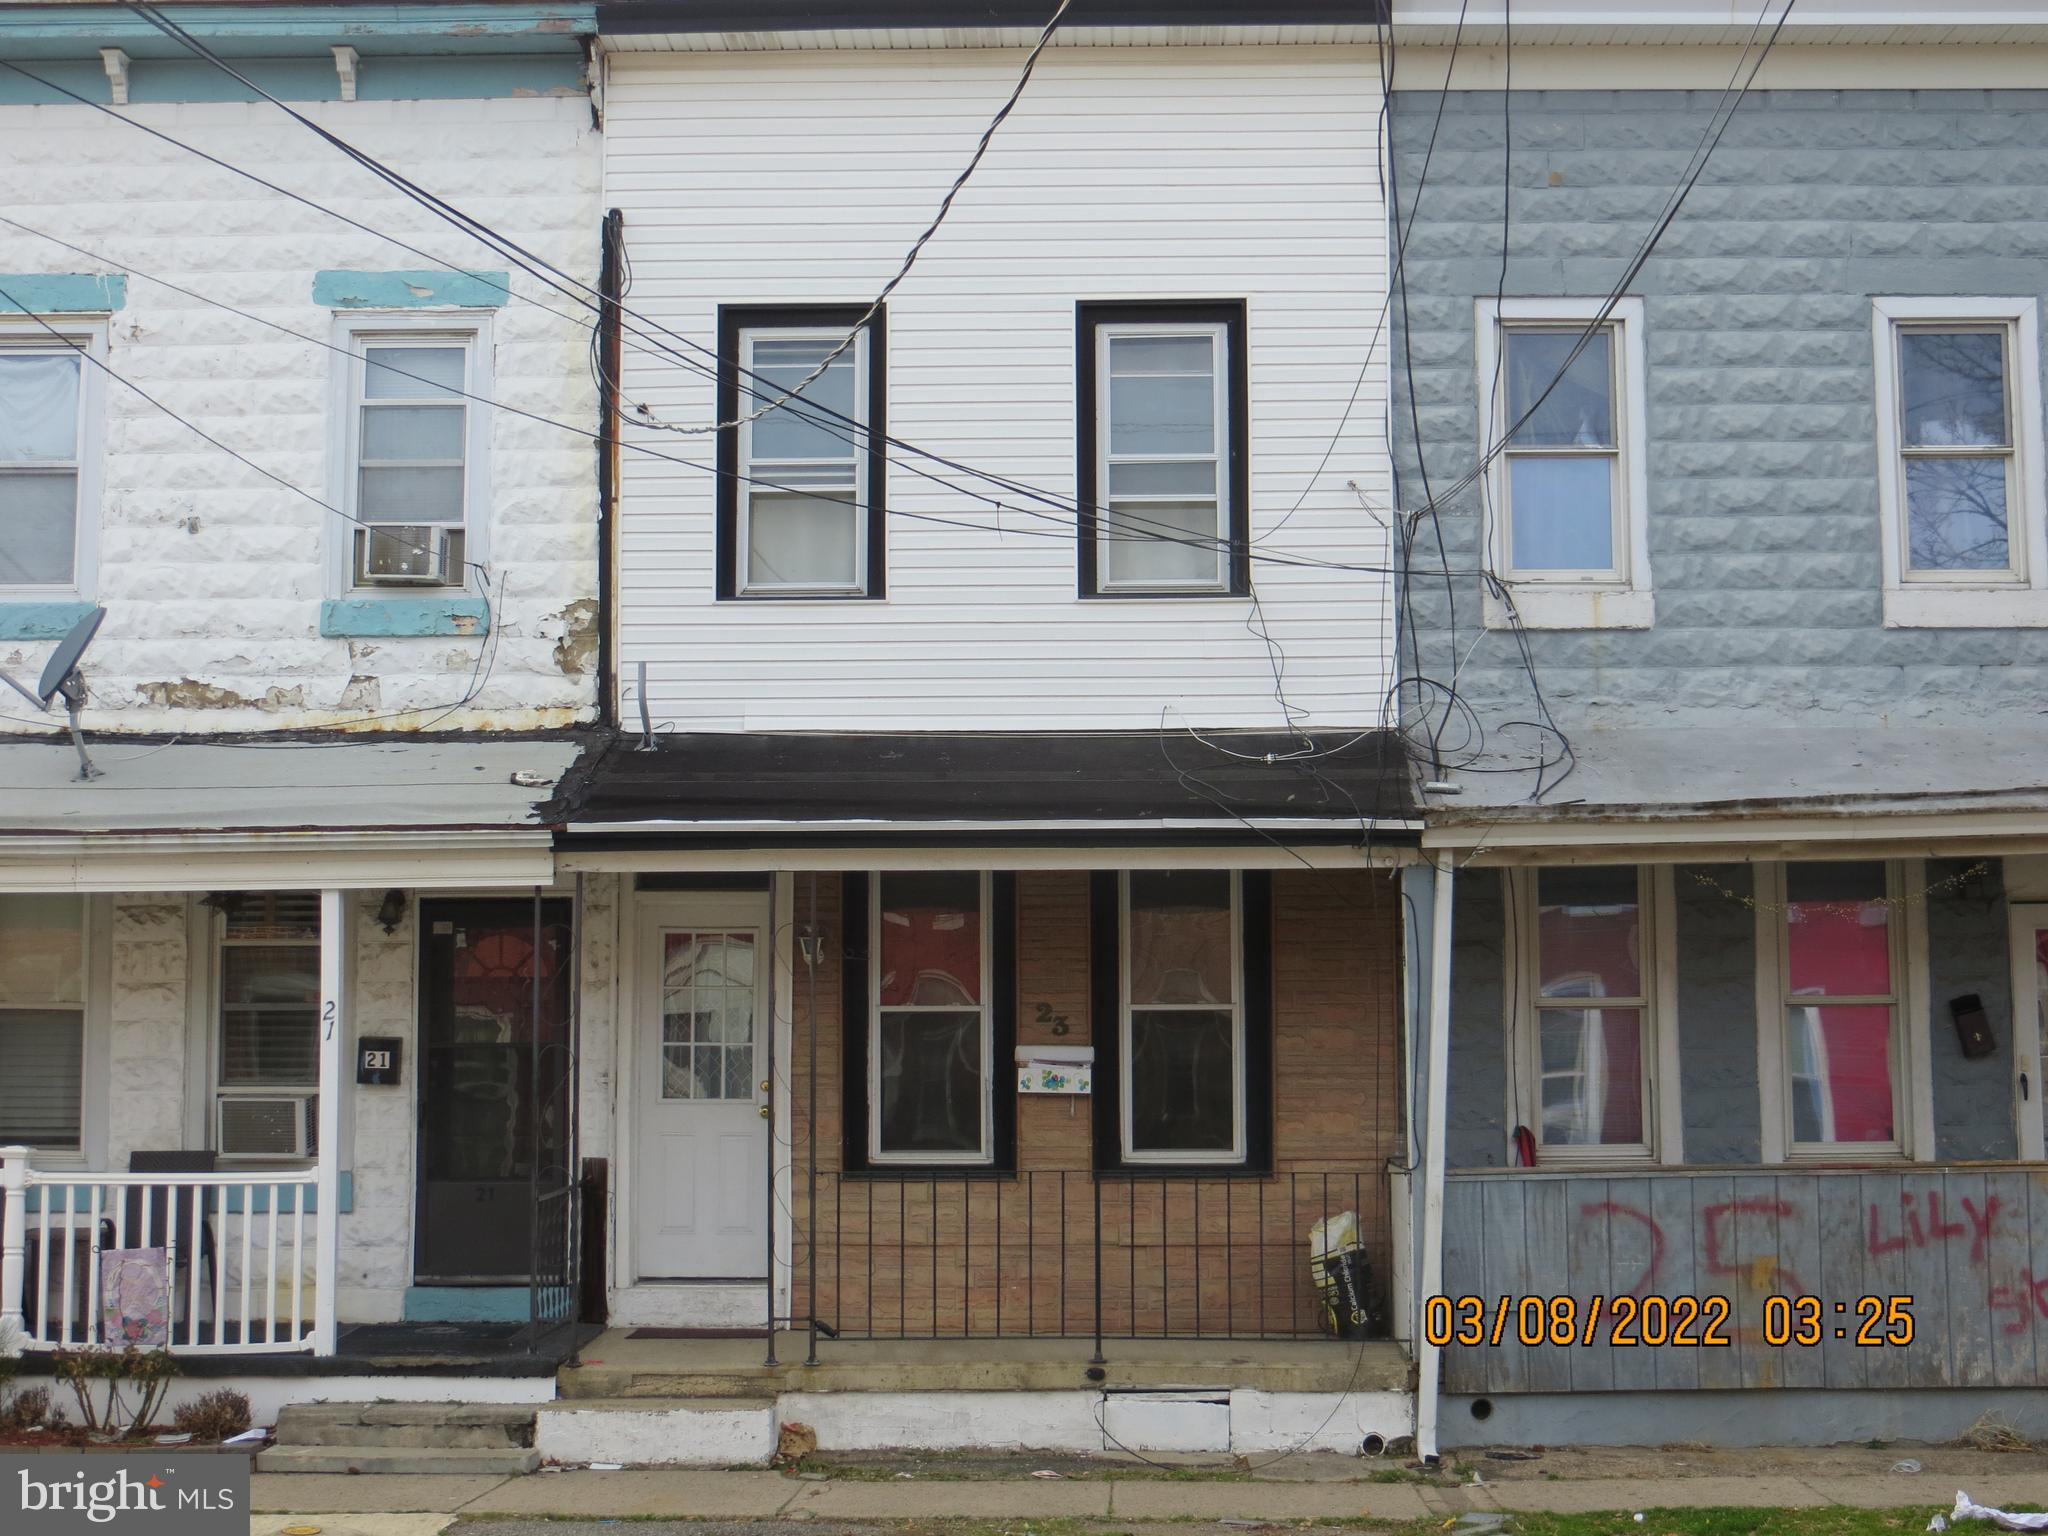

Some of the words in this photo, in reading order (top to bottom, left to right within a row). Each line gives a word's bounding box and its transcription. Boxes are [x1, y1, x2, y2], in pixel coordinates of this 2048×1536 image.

[323, 1000, 336, 1041] 21
[1036, 1002, 1069, 1036] 23
[367, 1052, 387, 1067] 21
[1347, 1283, 1358, 1311] Calcium
